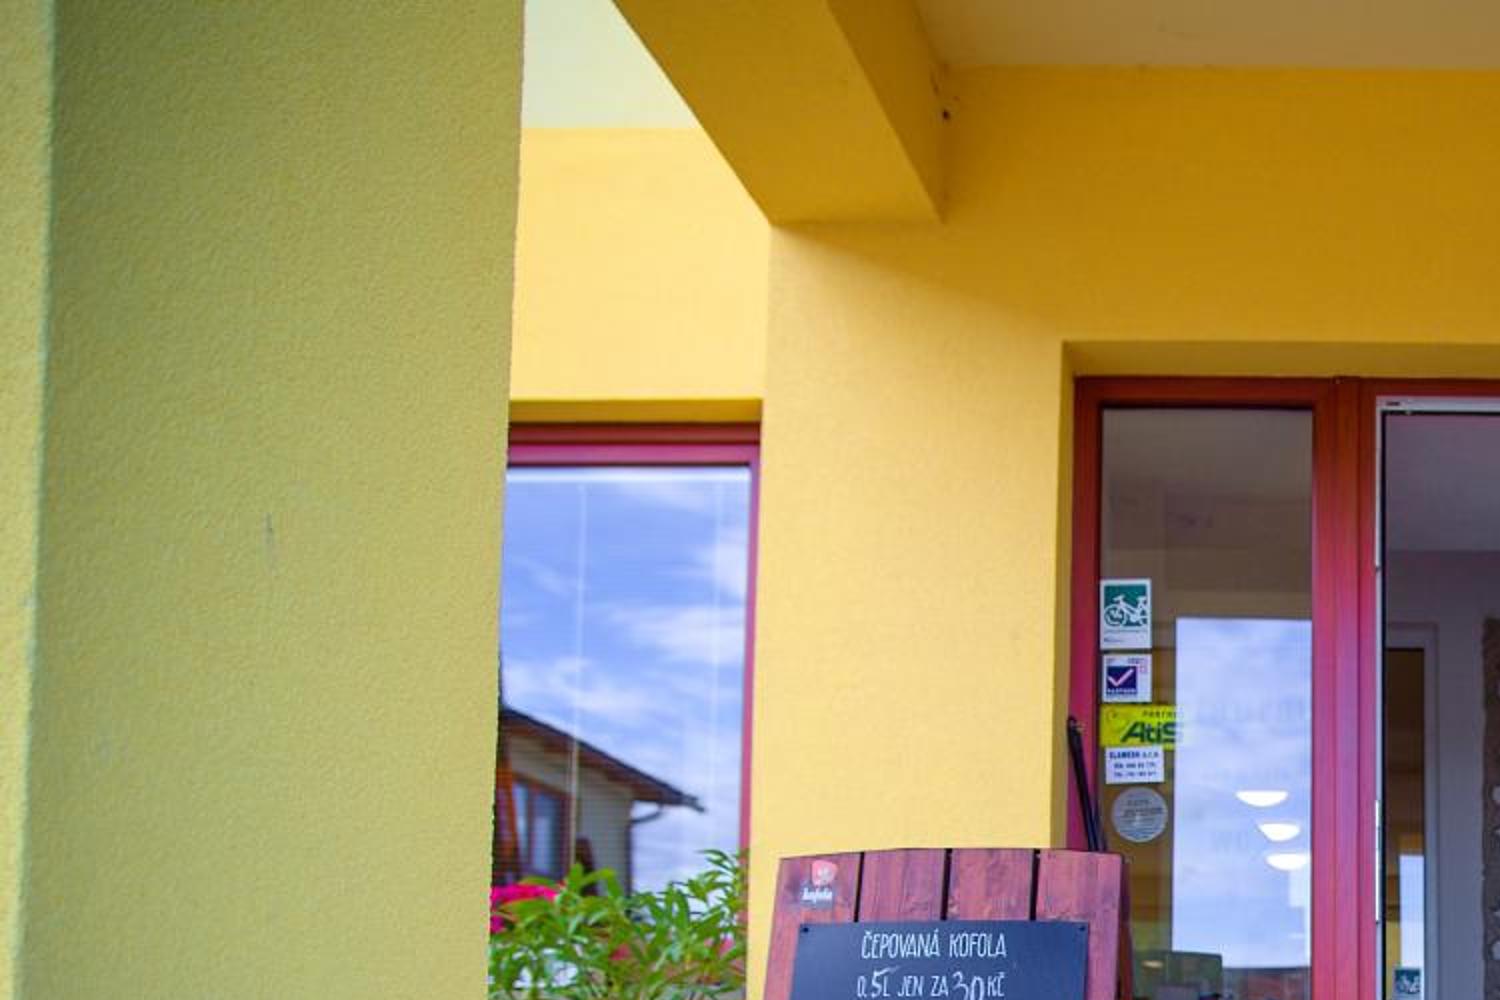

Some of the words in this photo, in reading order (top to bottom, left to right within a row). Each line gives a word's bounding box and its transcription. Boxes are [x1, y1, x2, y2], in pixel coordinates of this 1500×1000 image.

[861, 929, 940, 959] ČEPOVANÁ
[950, 932, 1007, 958] KOFOLA
[898, 975, 924, 997] JEN
[930, 975, 949, 997] ZA
[987, 972, 1005, 997] KČ
